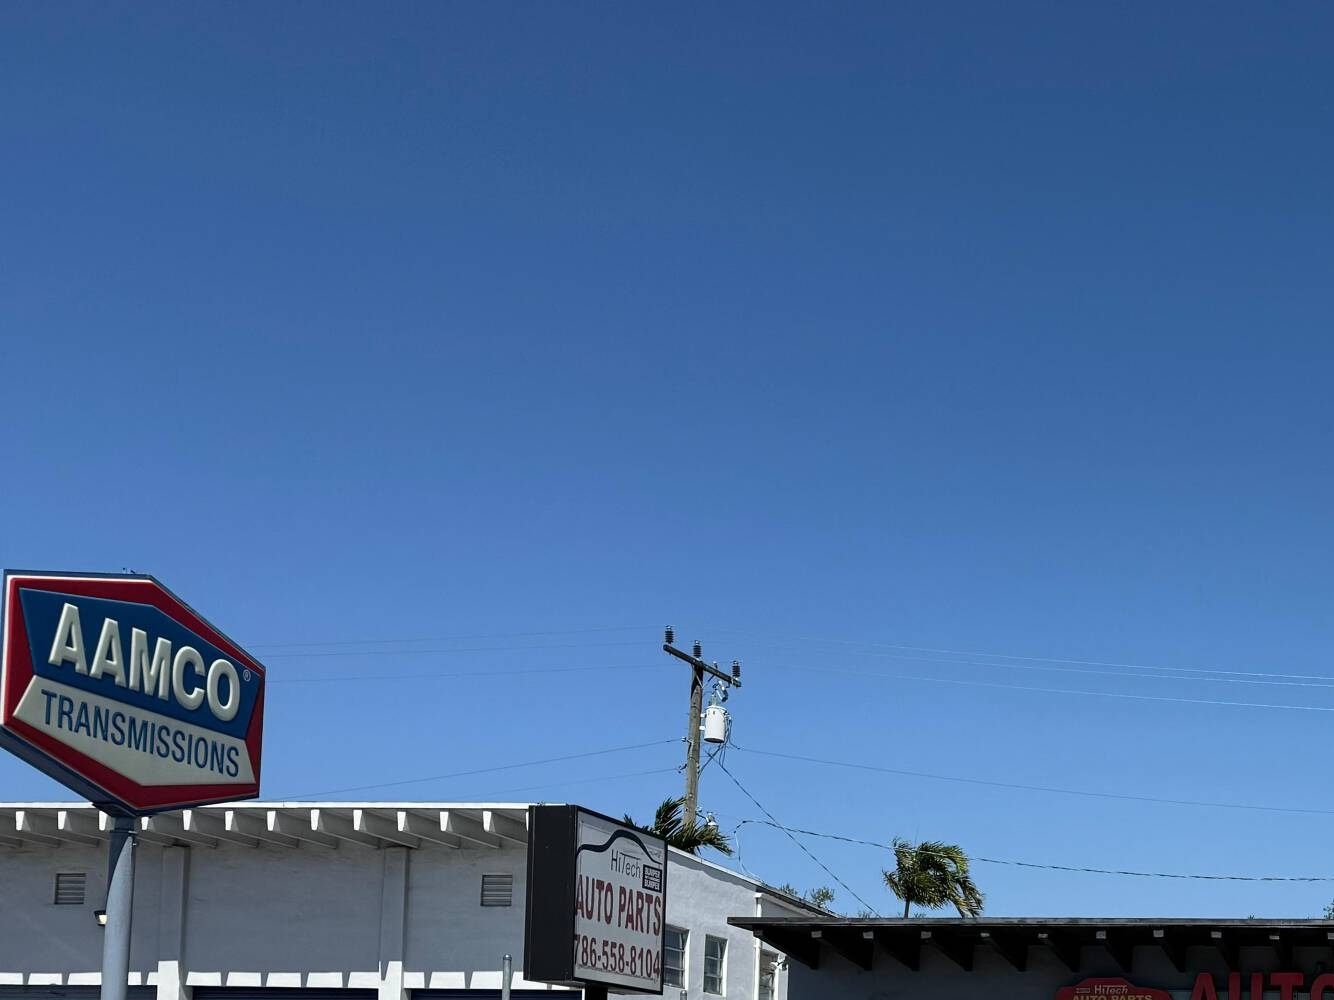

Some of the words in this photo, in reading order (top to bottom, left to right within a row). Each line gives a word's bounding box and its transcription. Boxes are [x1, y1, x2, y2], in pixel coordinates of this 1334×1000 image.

[48, 602, 240, 722] AAMCO
[41, 689, 240, 777] TRANSMISSIONS
[610, 849, 641, 878] HiTech
[575, 874, 614, 925] AUTO
[617, 885, 662, 937] PARTS
[574, 934, 661, 978] 786-558-8104
[1094, 984, 1129, 995] HiTech
